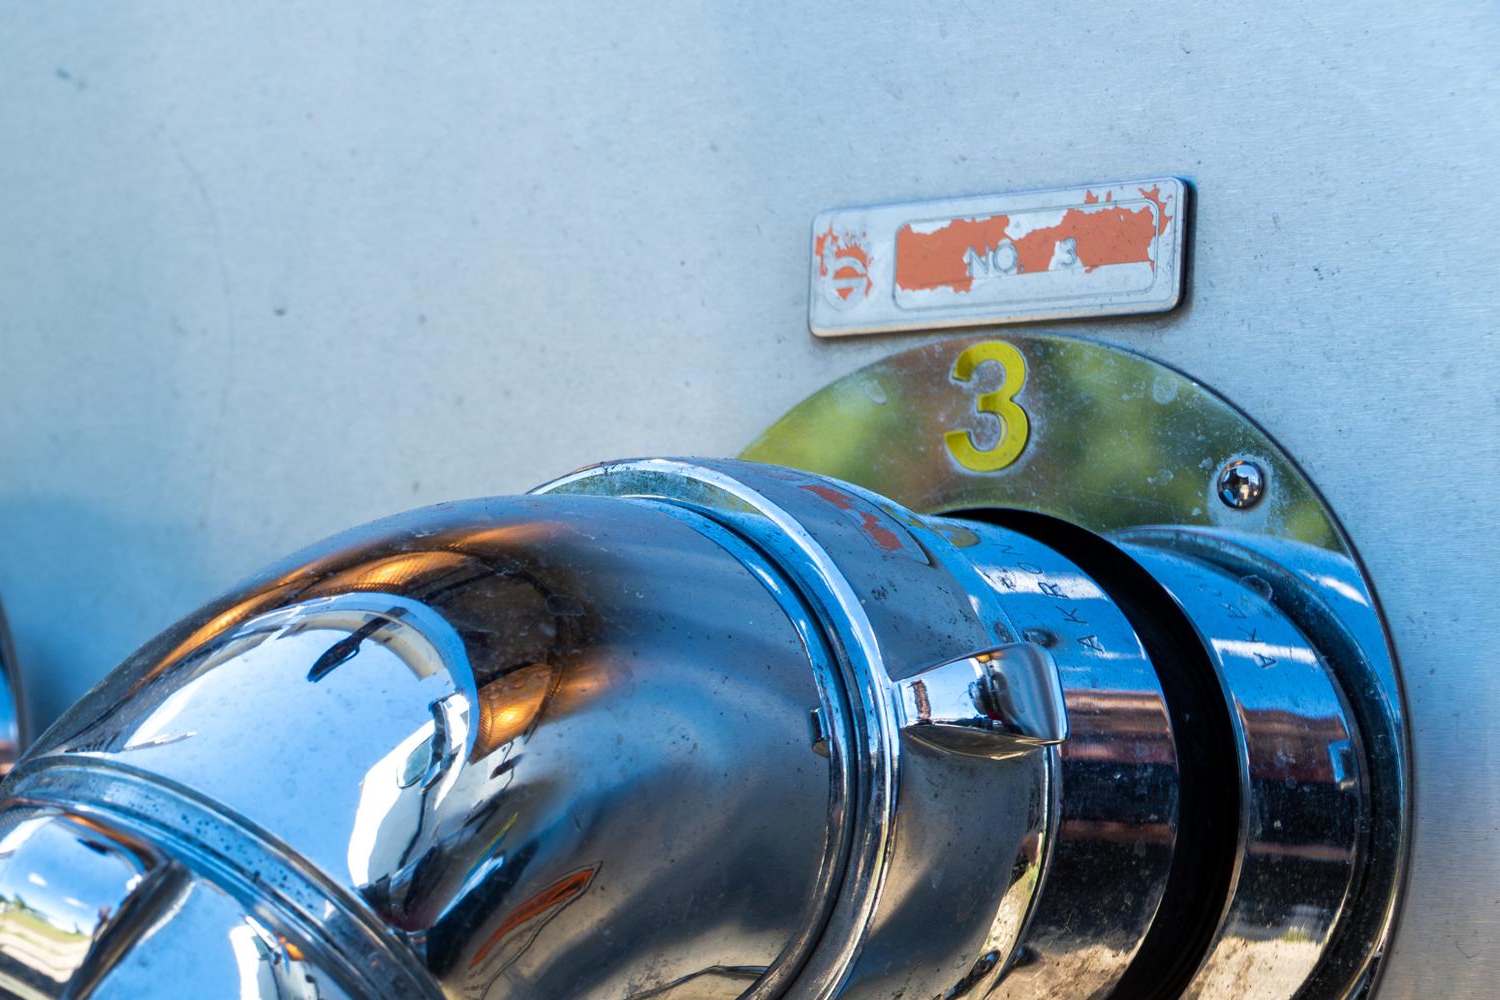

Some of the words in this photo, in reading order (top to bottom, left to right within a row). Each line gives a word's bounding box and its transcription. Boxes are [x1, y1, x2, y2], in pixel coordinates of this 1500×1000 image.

[1056, 236, 1078, 266] 3
[943, 340, 1030, 473] 3
[991, 542, 1106, 654] AKRON
